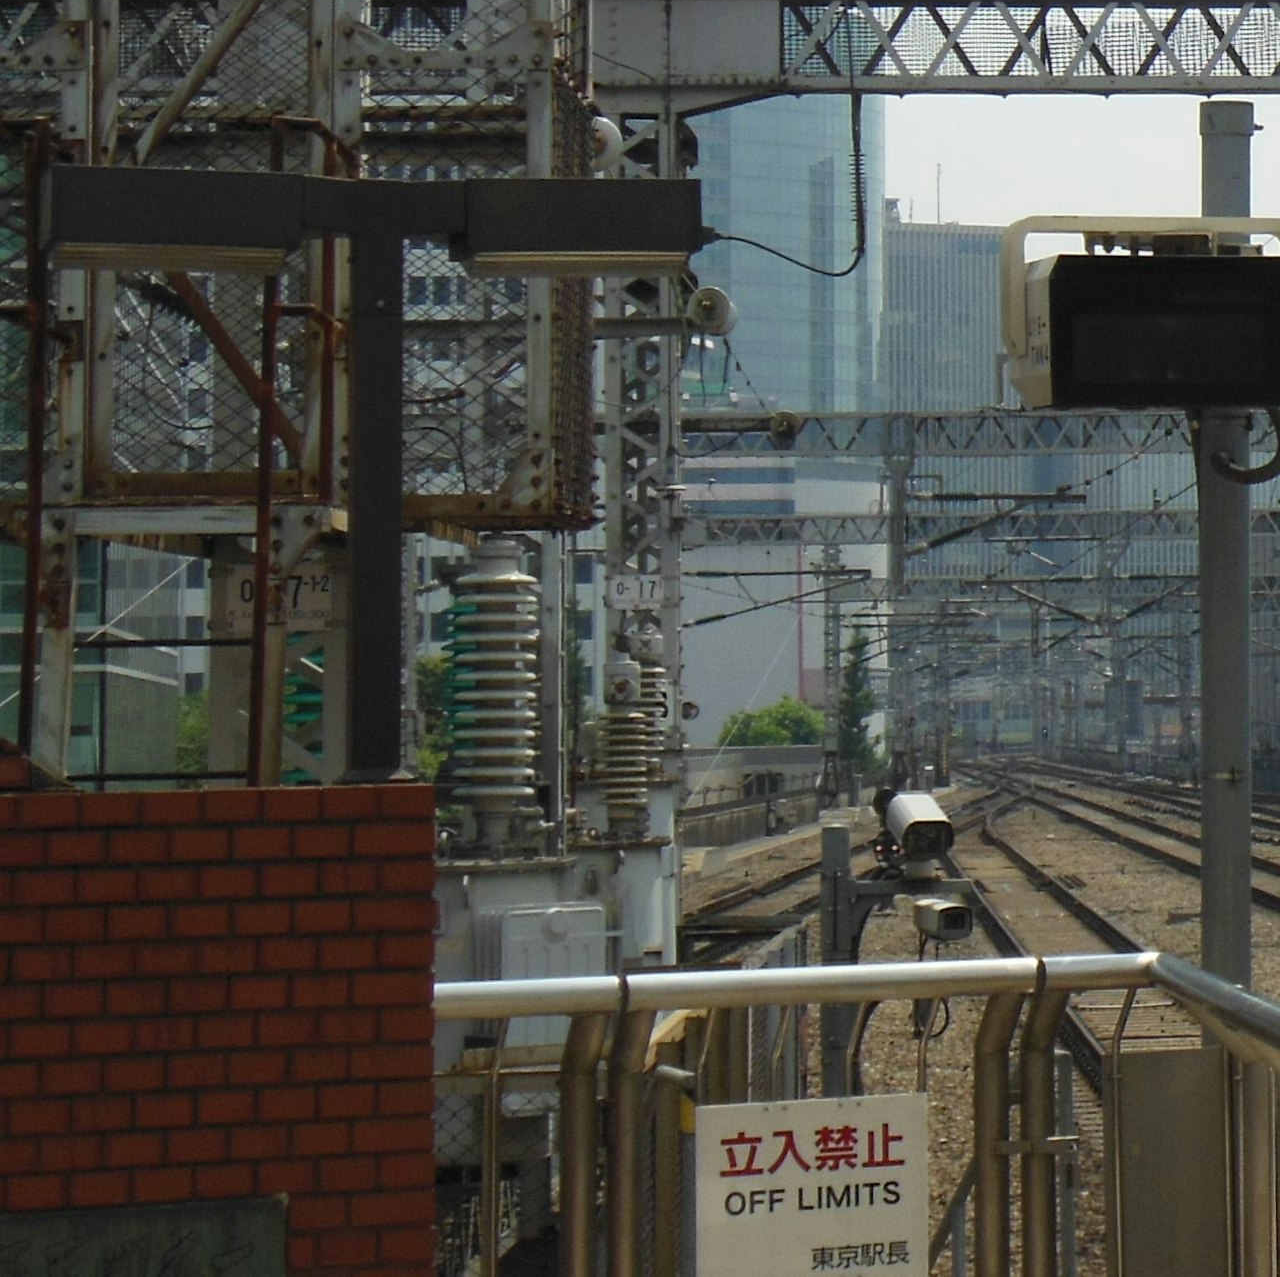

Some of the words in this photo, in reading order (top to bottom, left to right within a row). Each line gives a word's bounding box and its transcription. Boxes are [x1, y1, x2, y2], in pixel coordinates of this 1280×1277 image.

[720, 1123, 905, 1178] 立入禁止
[724, 1188, 785, 1216] OFF
[798, 1181, 901, 1211] LIMITS
[811, 1240, 910, 1271] 東京駅長
